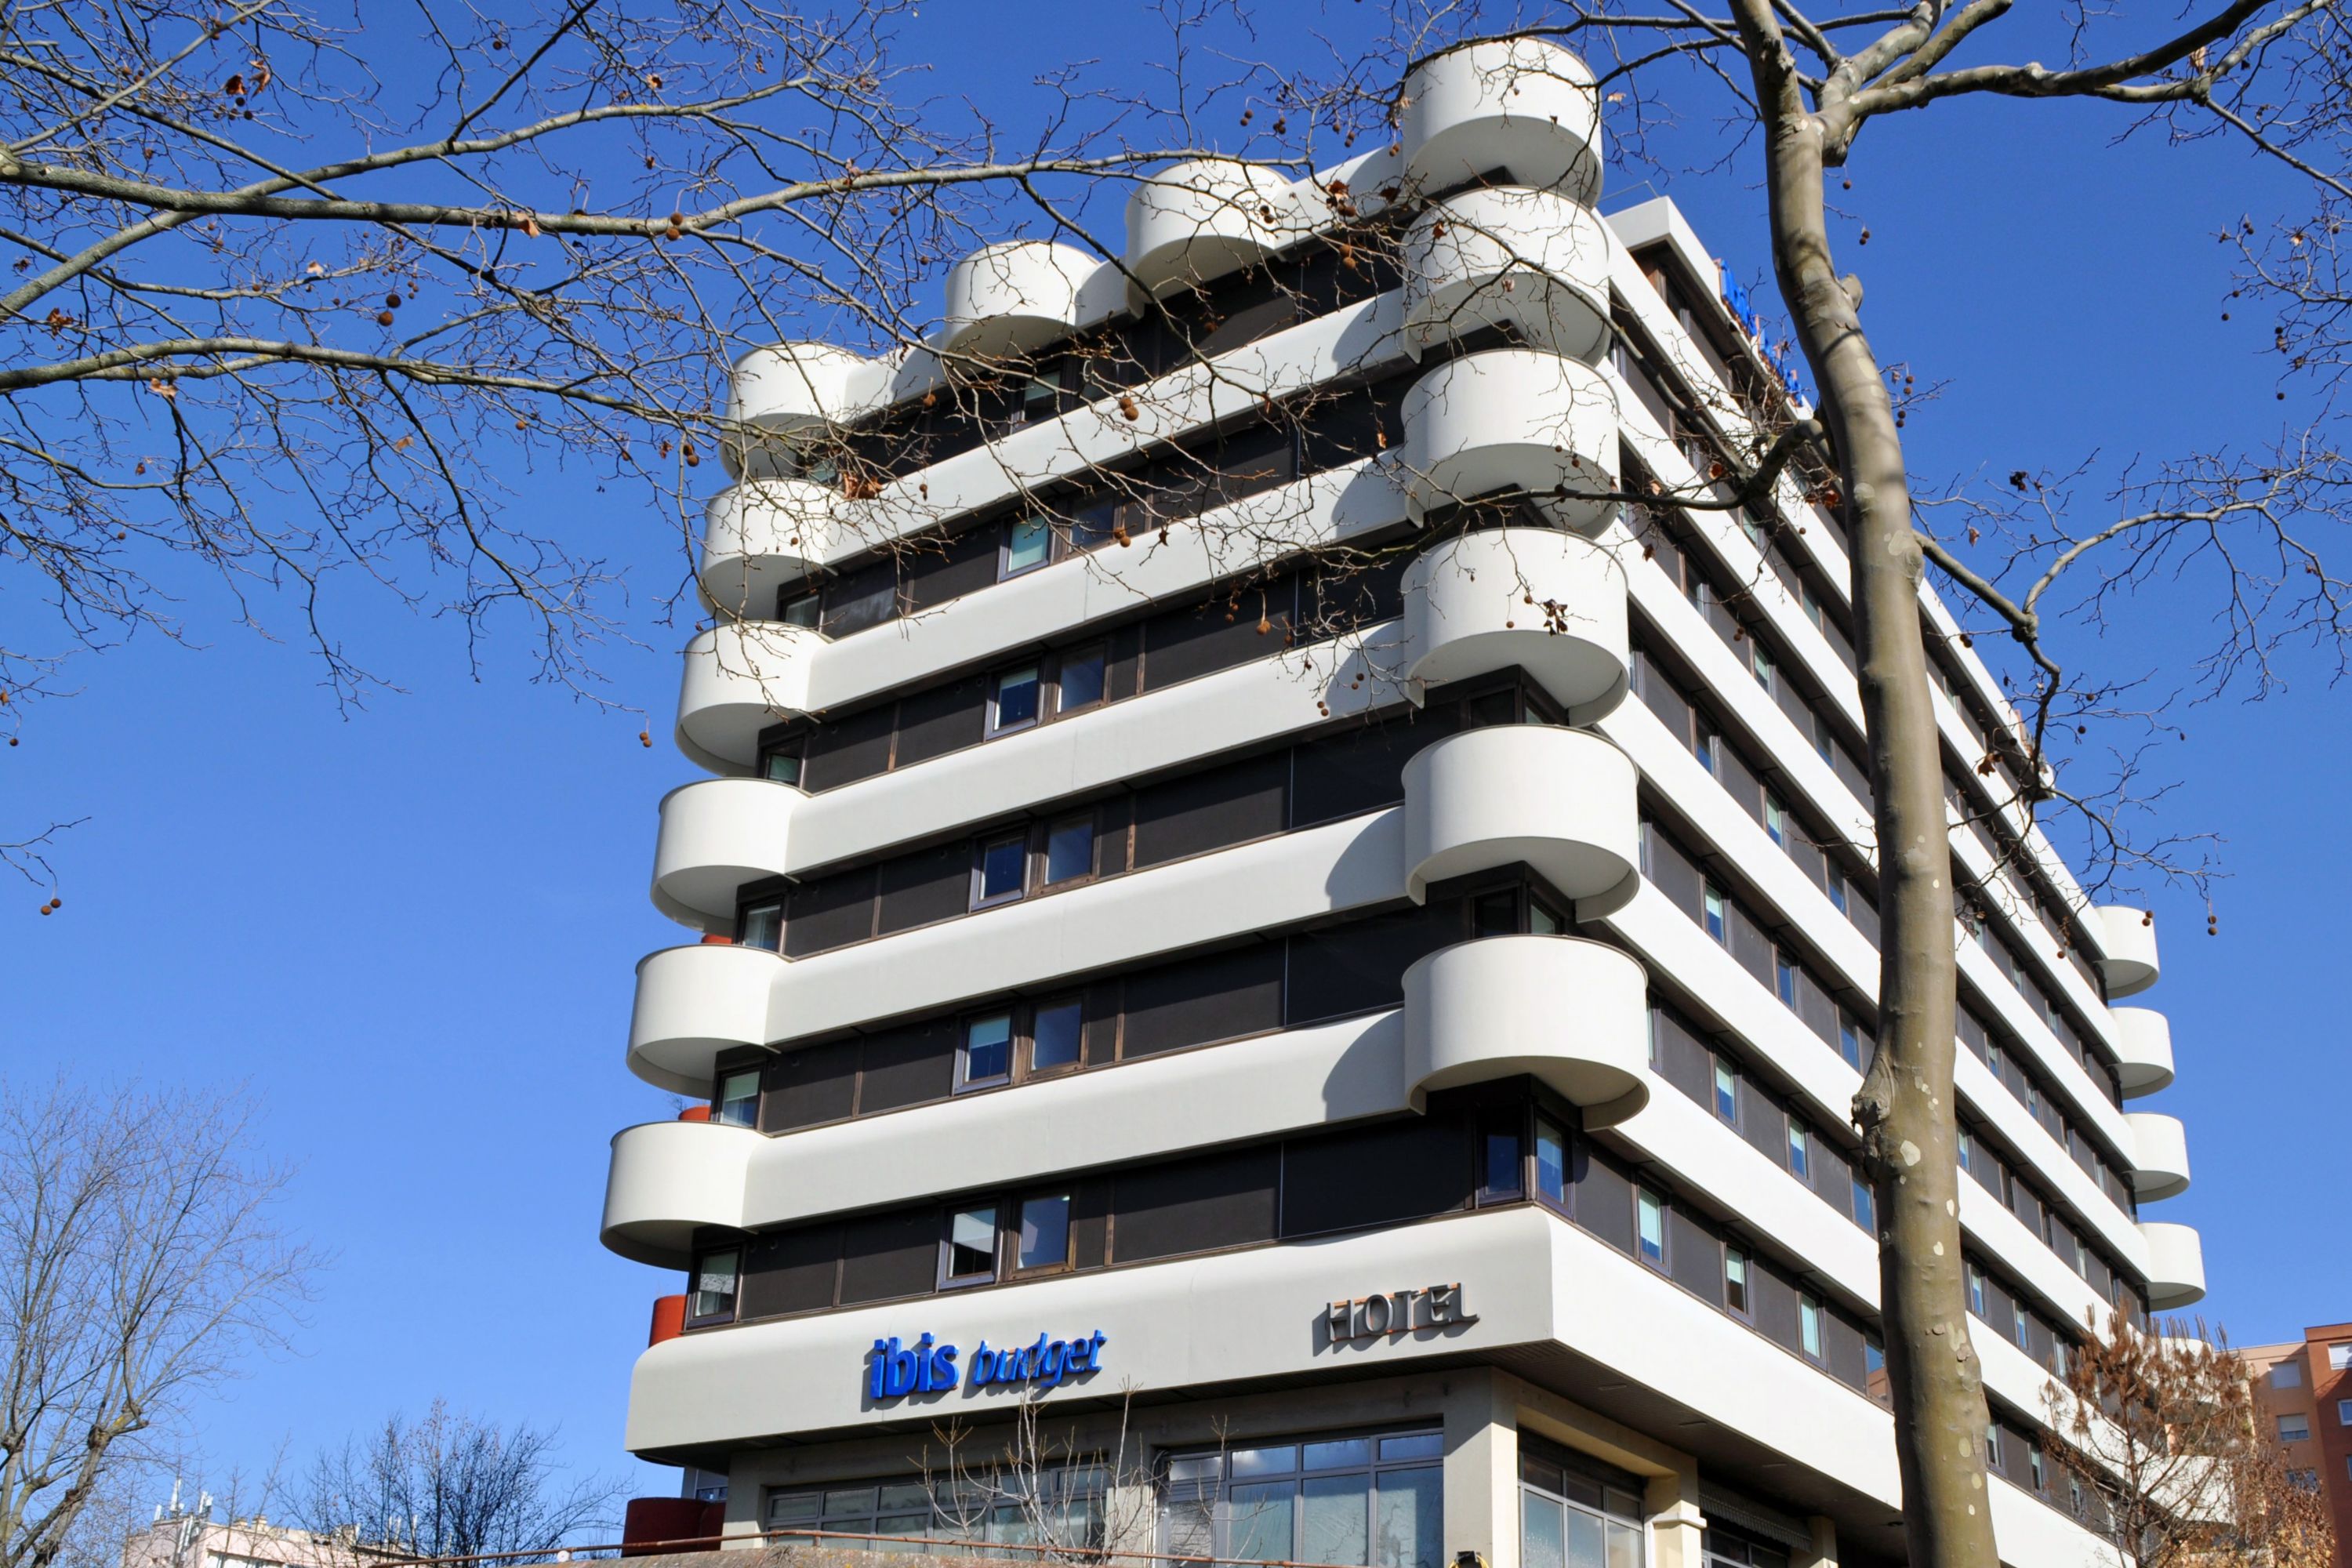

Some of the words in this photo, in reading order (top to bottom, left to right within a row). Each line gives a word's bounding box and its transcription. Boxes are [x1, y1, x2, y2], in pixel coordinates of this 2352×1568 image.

[1325, 1283, 1480, 1342] HOTEL
[869, 1331, 959, 1399] ibis
[972, 1329, 1108, 1388] budget
